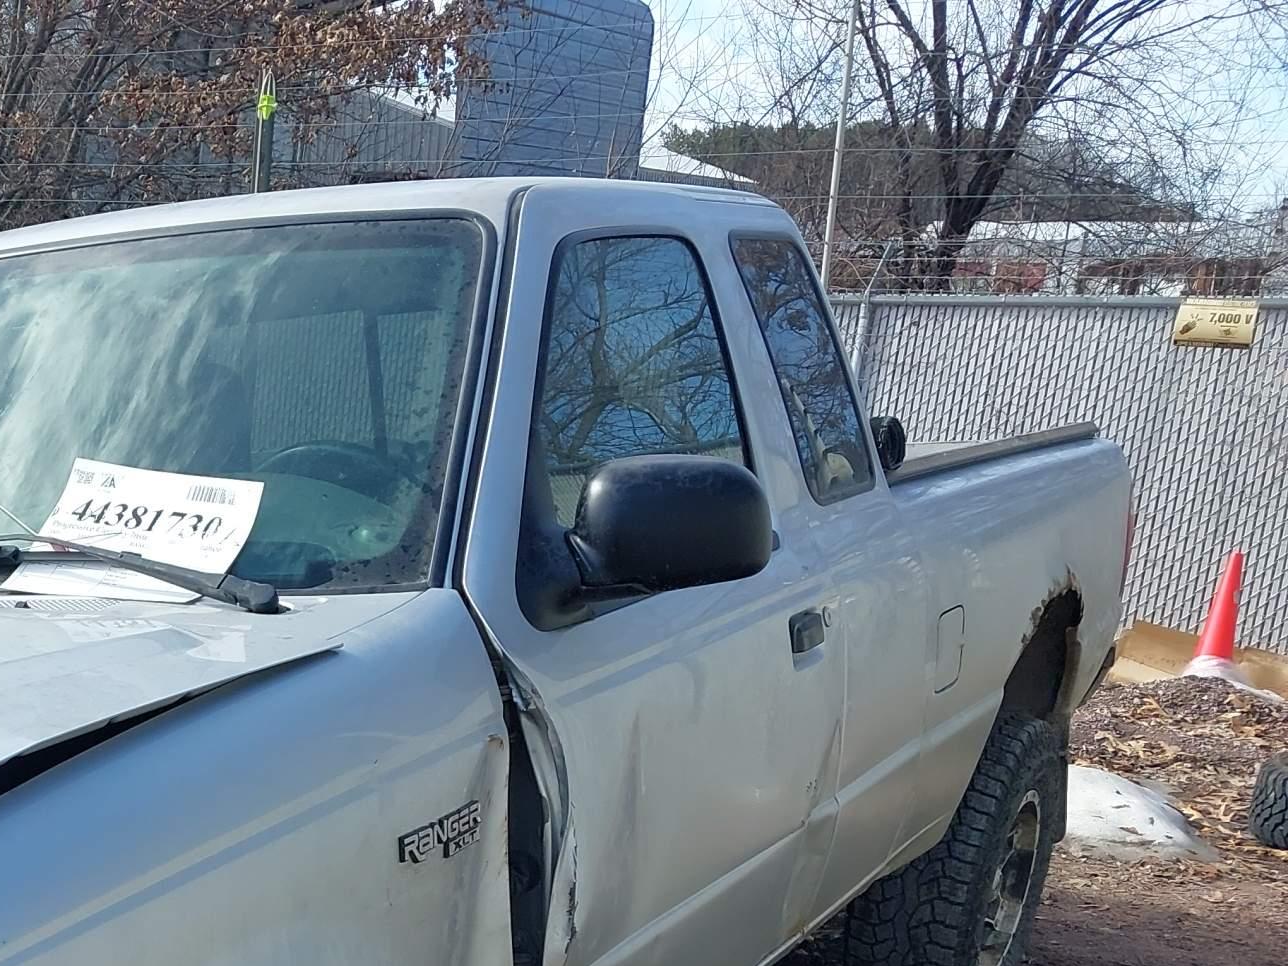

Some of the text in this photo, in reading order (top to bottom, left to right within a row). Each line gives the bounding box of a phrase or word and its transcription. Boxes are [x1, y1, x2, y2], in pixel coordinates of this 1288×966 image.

[1209, 312, 1253, 325] 7,000 V
[71, 498, 223, 542] 44381730
[451, 828, 479, 854] XLT
